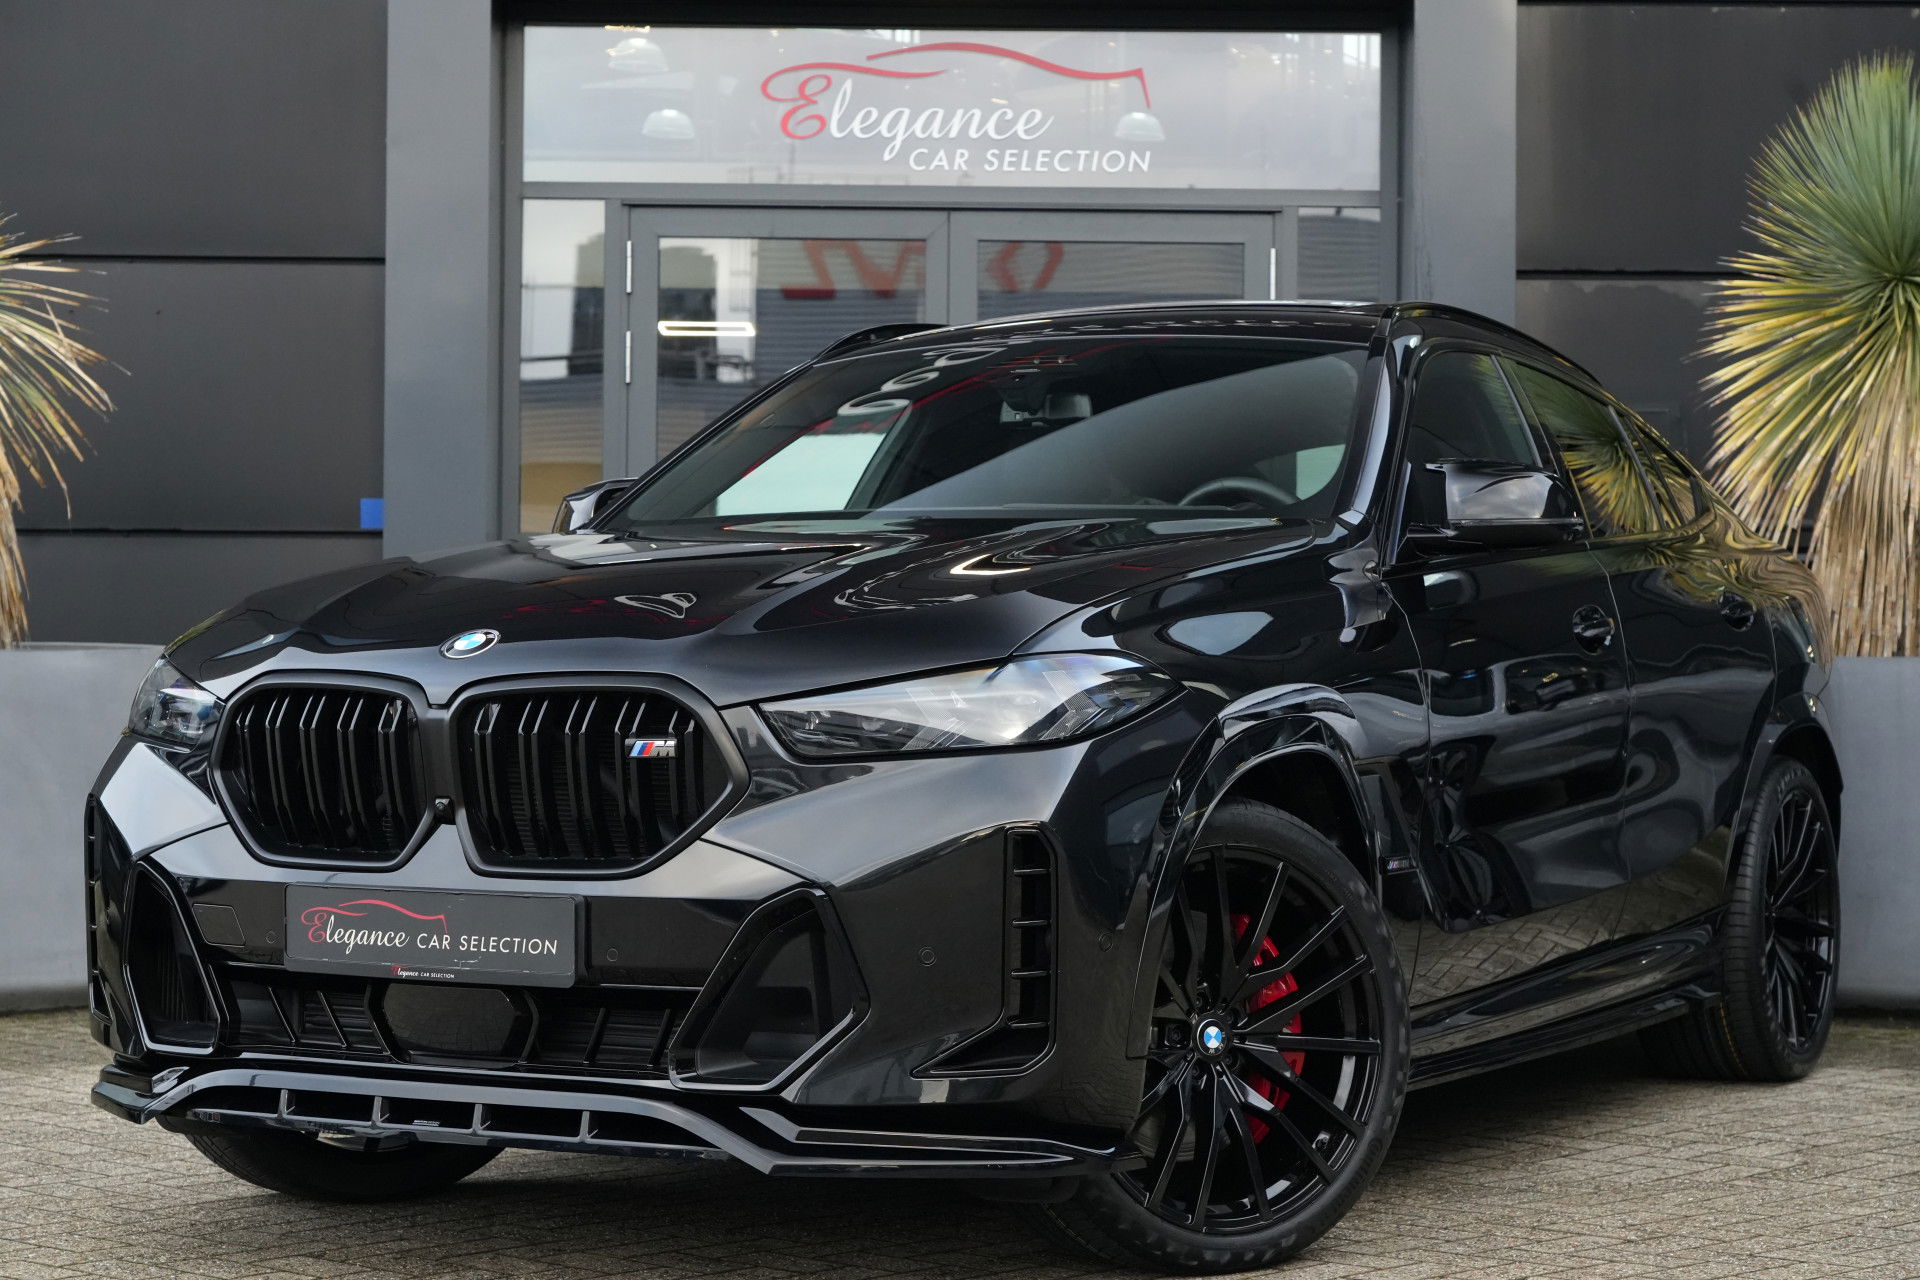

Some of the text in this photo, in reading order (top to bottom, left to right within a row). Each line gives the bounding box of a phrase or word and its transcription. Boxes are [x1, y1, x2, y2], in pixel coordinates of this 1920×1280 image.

[761, 63, 1054, 162] Elegance
[908, 148, 1152, 173] CAR SELECTION
[301, 906, 558, 955] Elegance CAR SELECTION
